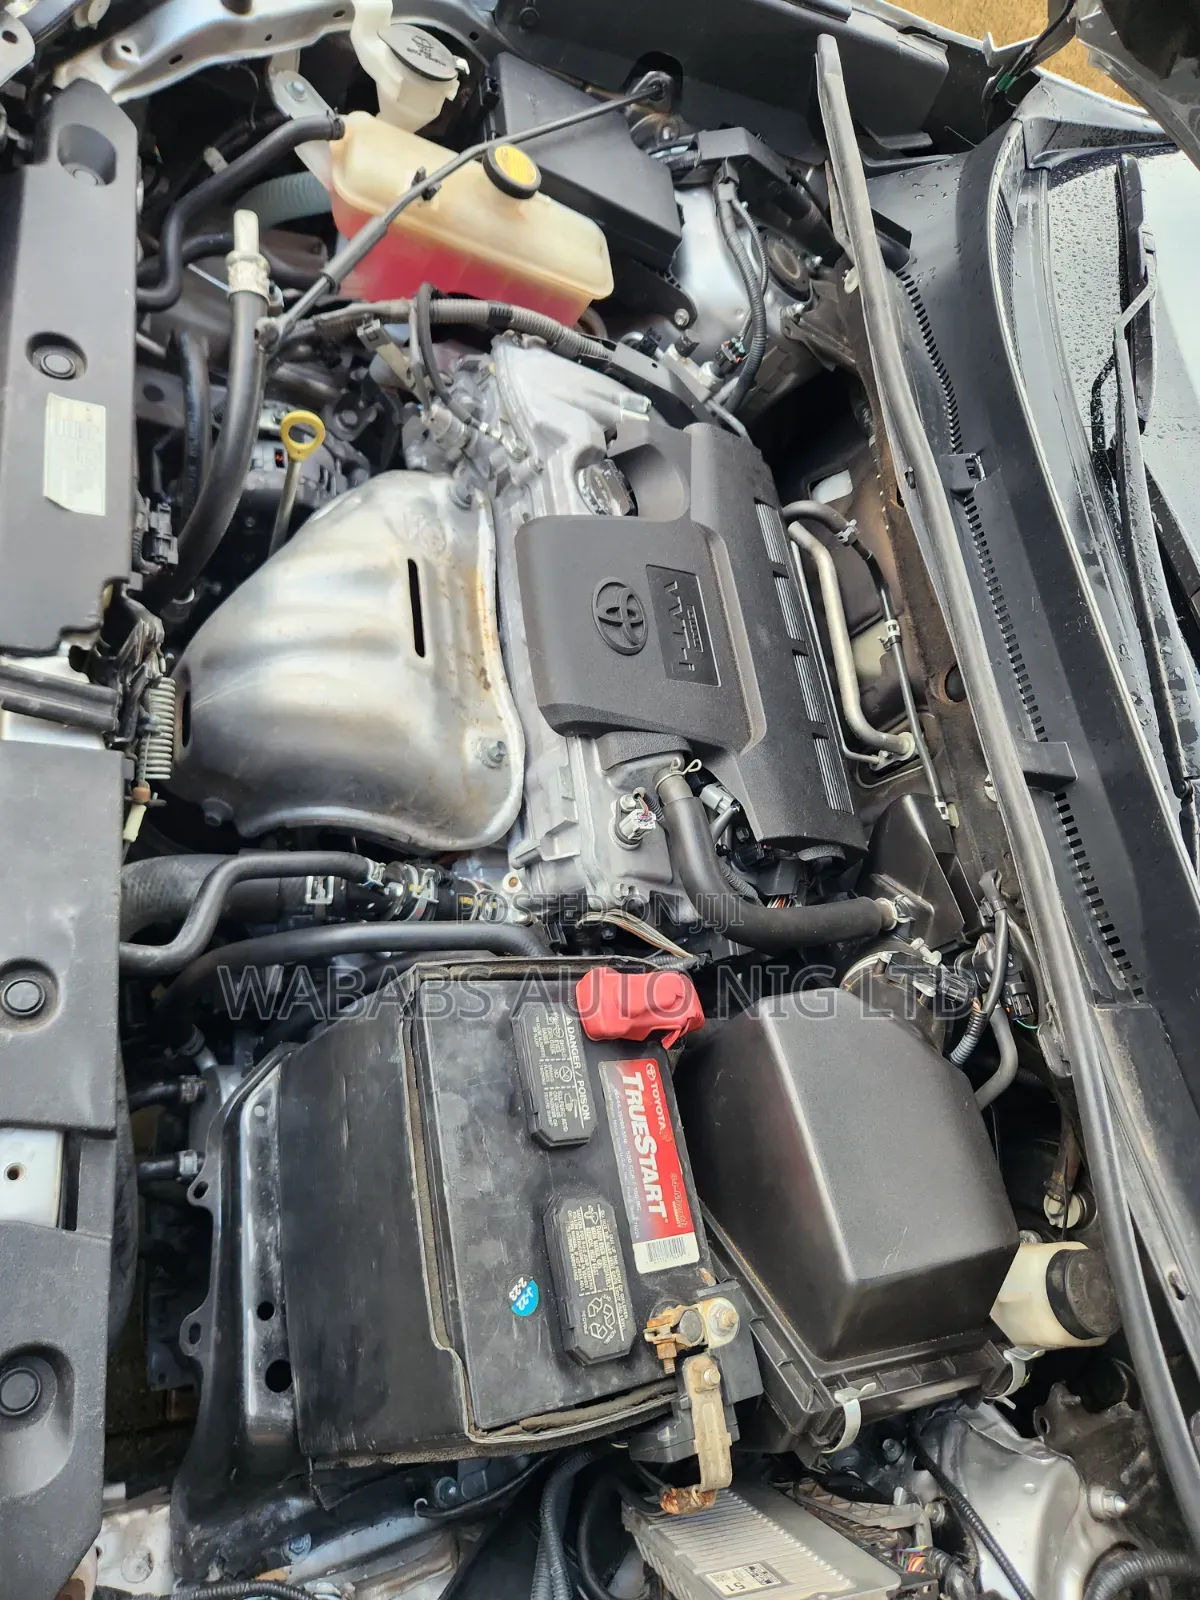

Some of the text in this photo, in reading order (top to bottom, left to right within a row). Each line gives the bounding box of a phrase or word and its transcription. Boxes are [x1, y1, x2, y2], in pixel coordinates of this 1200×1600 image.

[567, 1026, 581, 1069] DANGER
[577, 1080, 591, 1120] POISON
[651, 1082, 665, 1131] TOYOTA
[509, 1276, 527, 1301] 2-23
